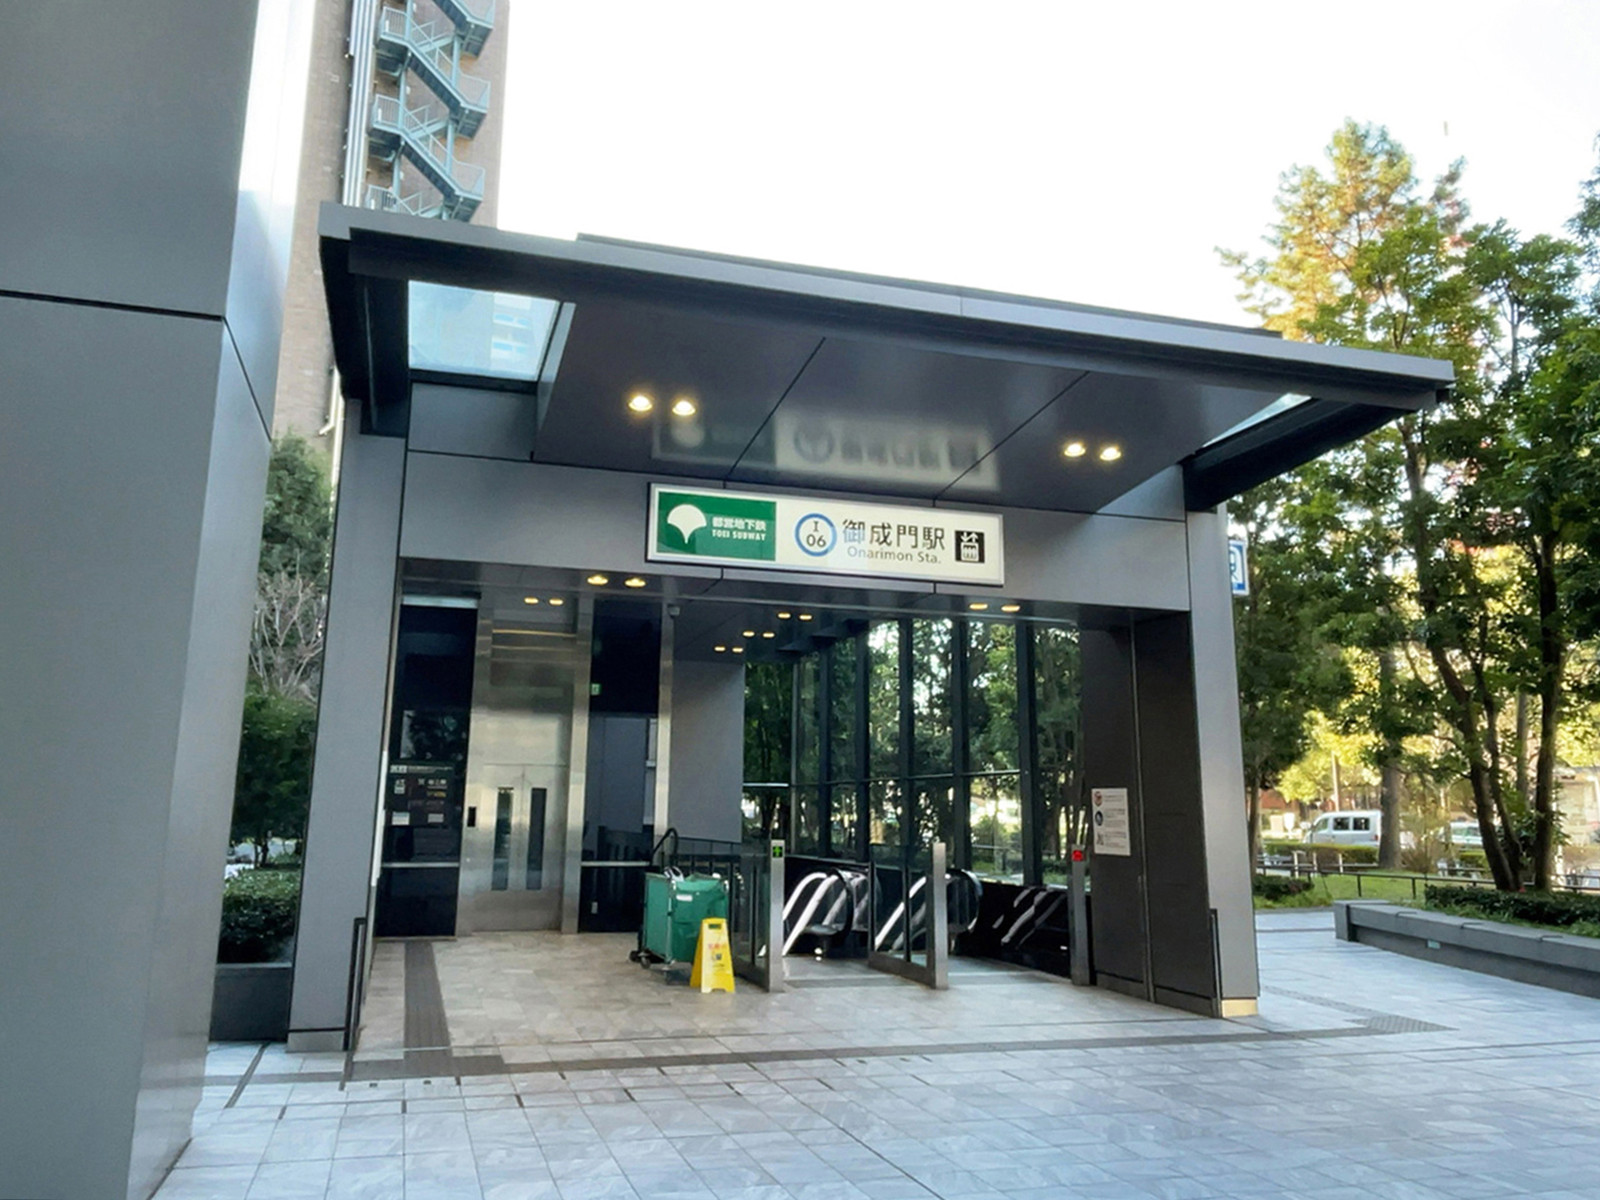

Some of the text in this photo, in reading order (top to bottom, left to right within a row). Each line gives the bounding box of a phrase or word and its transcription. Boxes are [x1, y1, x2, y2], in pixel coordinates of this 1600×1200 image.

[712, 516, 767, 531] 都営地下鉄
[813, 520, 819, 532] I
[712, 529, 766, 541] TOEI SUBWAY
[806, 533, 827, 548] 06
[842, 519, 945, 550] 御成門駅
[847, 545, 942, 564] Onarimon Sta.
